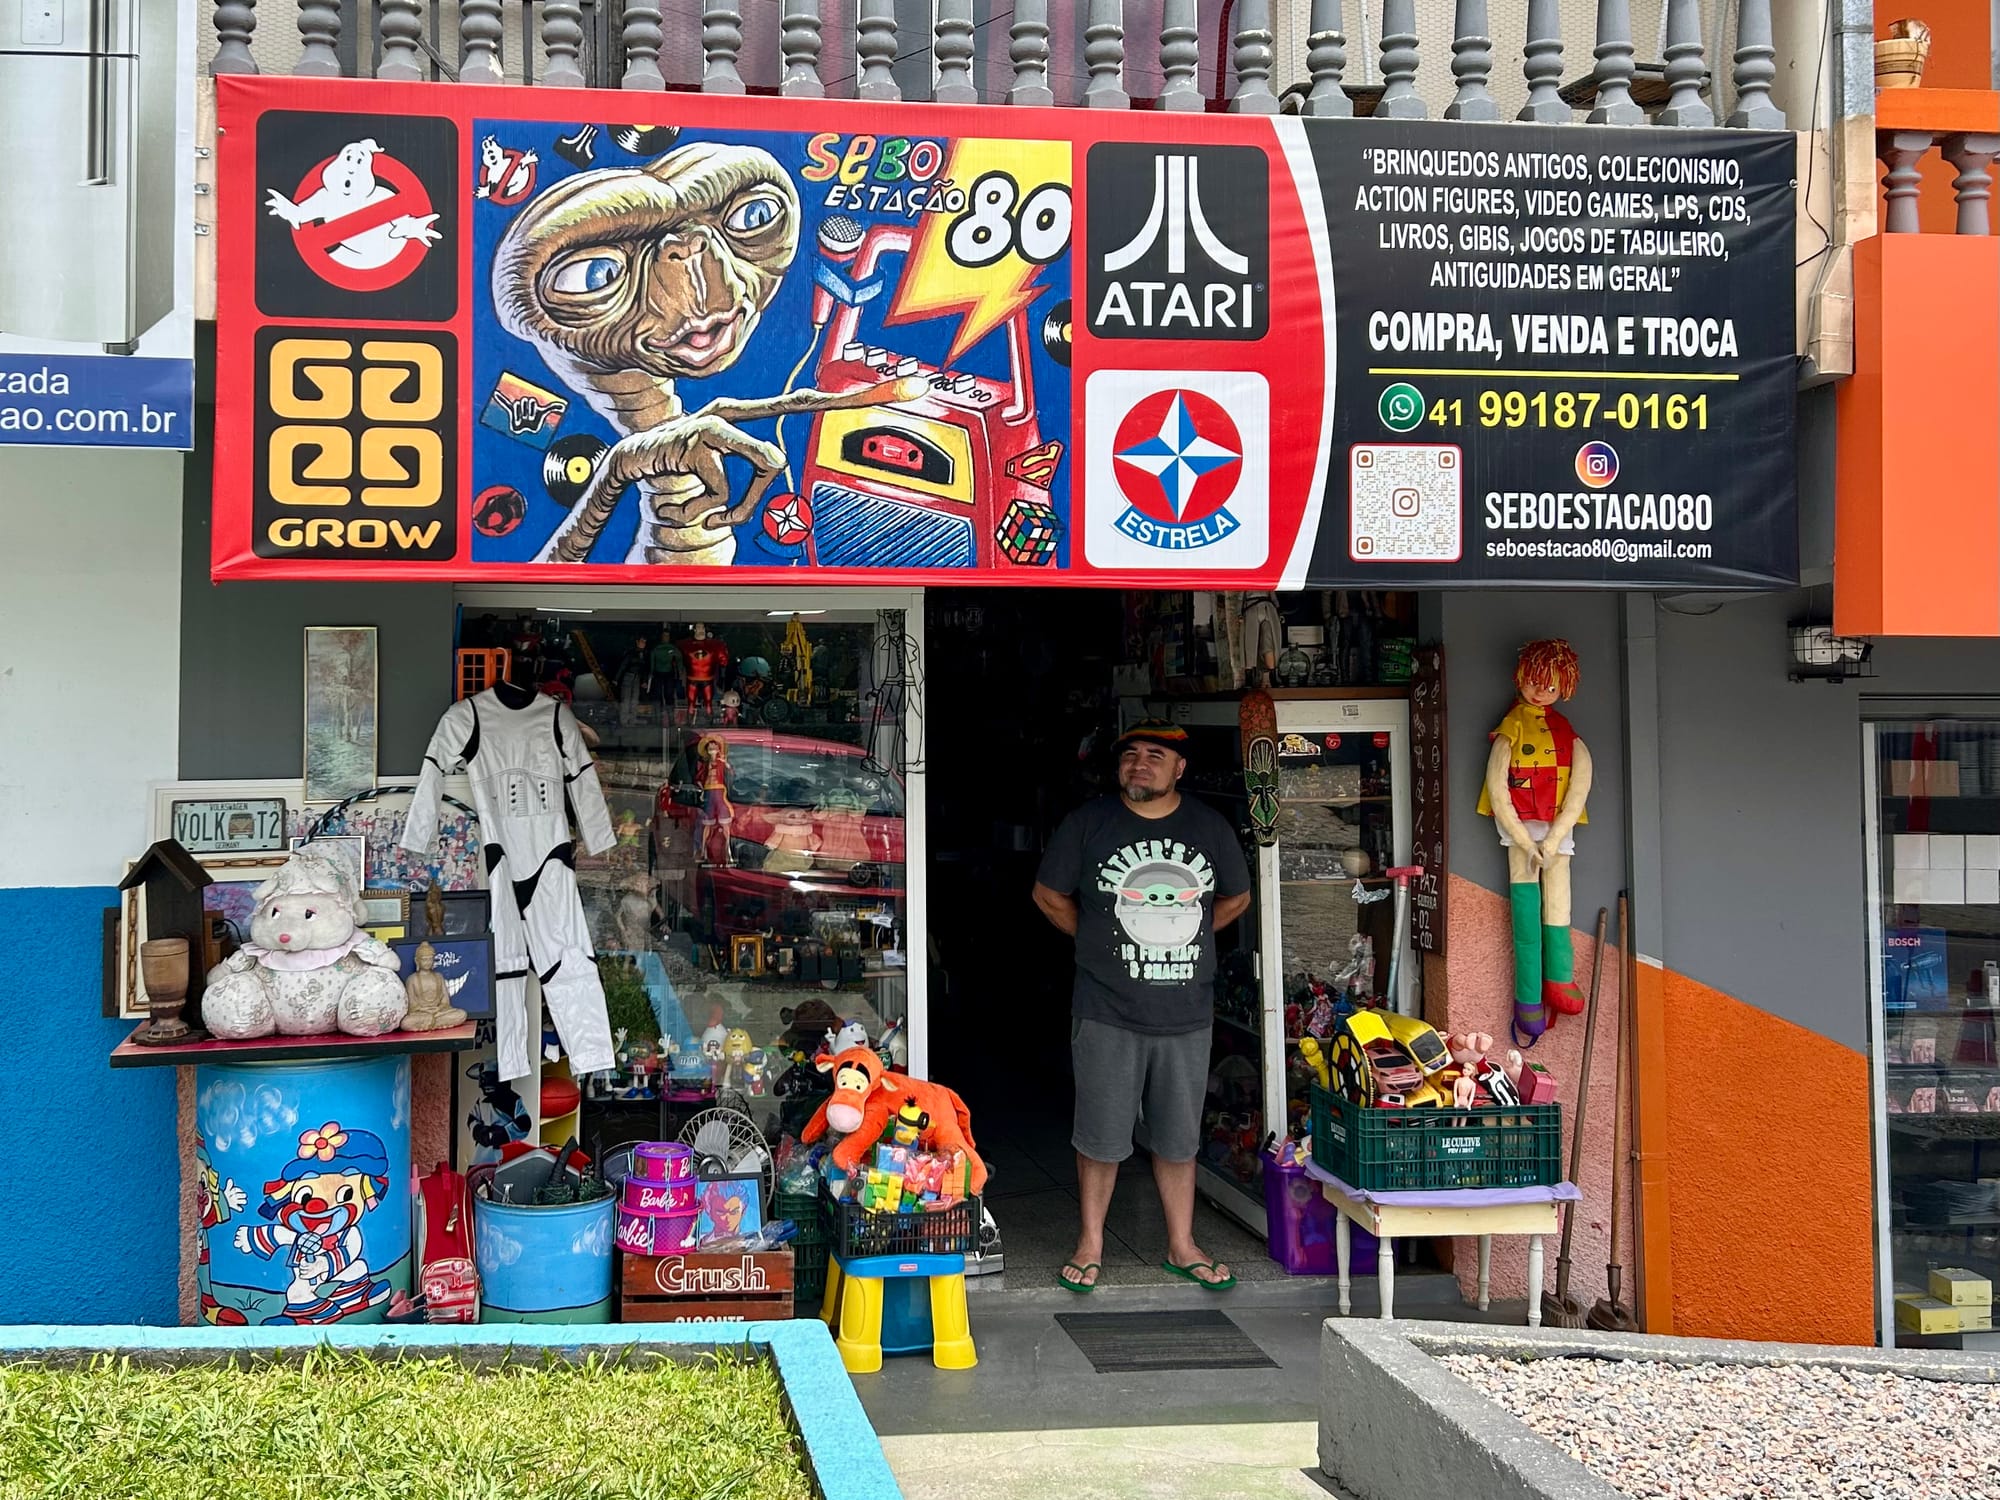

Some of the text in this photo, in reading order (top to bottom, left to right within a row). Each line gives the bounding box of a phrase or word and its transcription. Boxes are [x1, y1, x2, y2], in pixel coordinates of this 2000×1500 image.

[1504, 153, 1592, 184] ANTIGOS,
[1598, 155, 1743, 190] COLECIONISMO,
[824, 170, 1072, 268] ESTAÇÃO 80
[1355, 185, 1751, 227] ACTION FIGURES, VIDEO GAMES, LPS, CDS,
[1379, 222, 1729, 262] LIVROS, GIBIS, JOGOS DE TABULEIRO,
[1430, 261, 1571, 290] ANTIGUIDADES
[1577, 265, 1603, 291] EM
[1095, 281, 1253, 328] ATARI
[1369, 311, 1739, 361] COMPRA, VENDA E TROCA
[1428, 391, 1707, 430] 41 99187-0161
[1121, 511, 1234, 549] ESTRELA
[1485, 492, 1713, 531] SEBOESTACAO80
[267, 517, 442, 550] GROW
[1486, 537, 1712, 563] seboestacao80@gmail.com
[177, 811, 280, 842] VOLK T2
[1420, 873, 1438, 894] PAZ
[1121, 943, 1136, 960] IS
[1888, 938, 1921, 947] BOSCH
